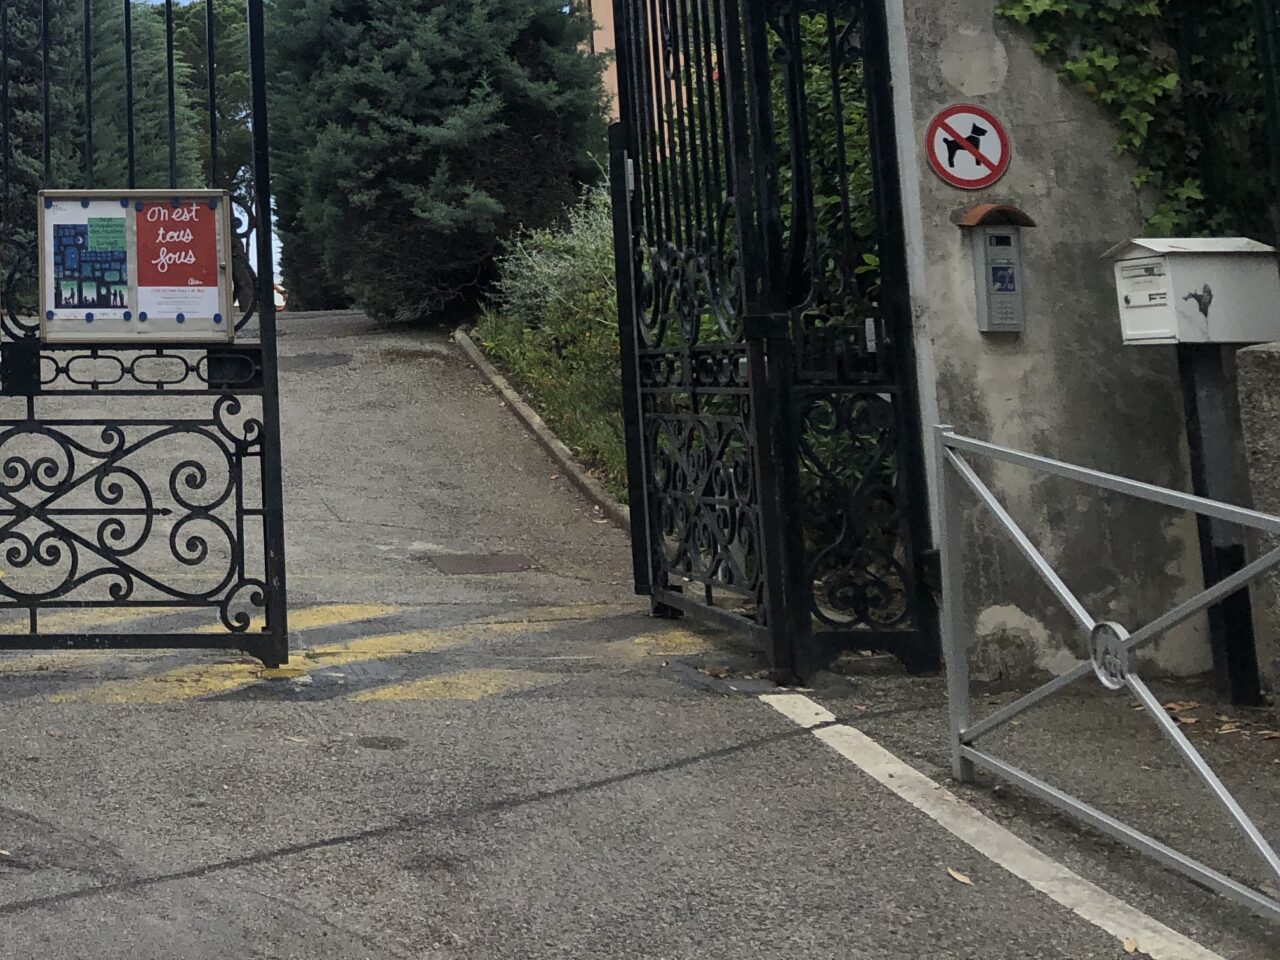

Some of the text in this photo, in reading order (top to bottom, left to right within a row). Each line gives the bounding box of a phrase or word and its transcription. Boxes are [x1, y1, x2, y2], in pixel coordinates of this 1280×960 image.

[171, 201, 200, 222] est
[155, 226, 194, 243] tous
[151, 246, 196, 273] fous
